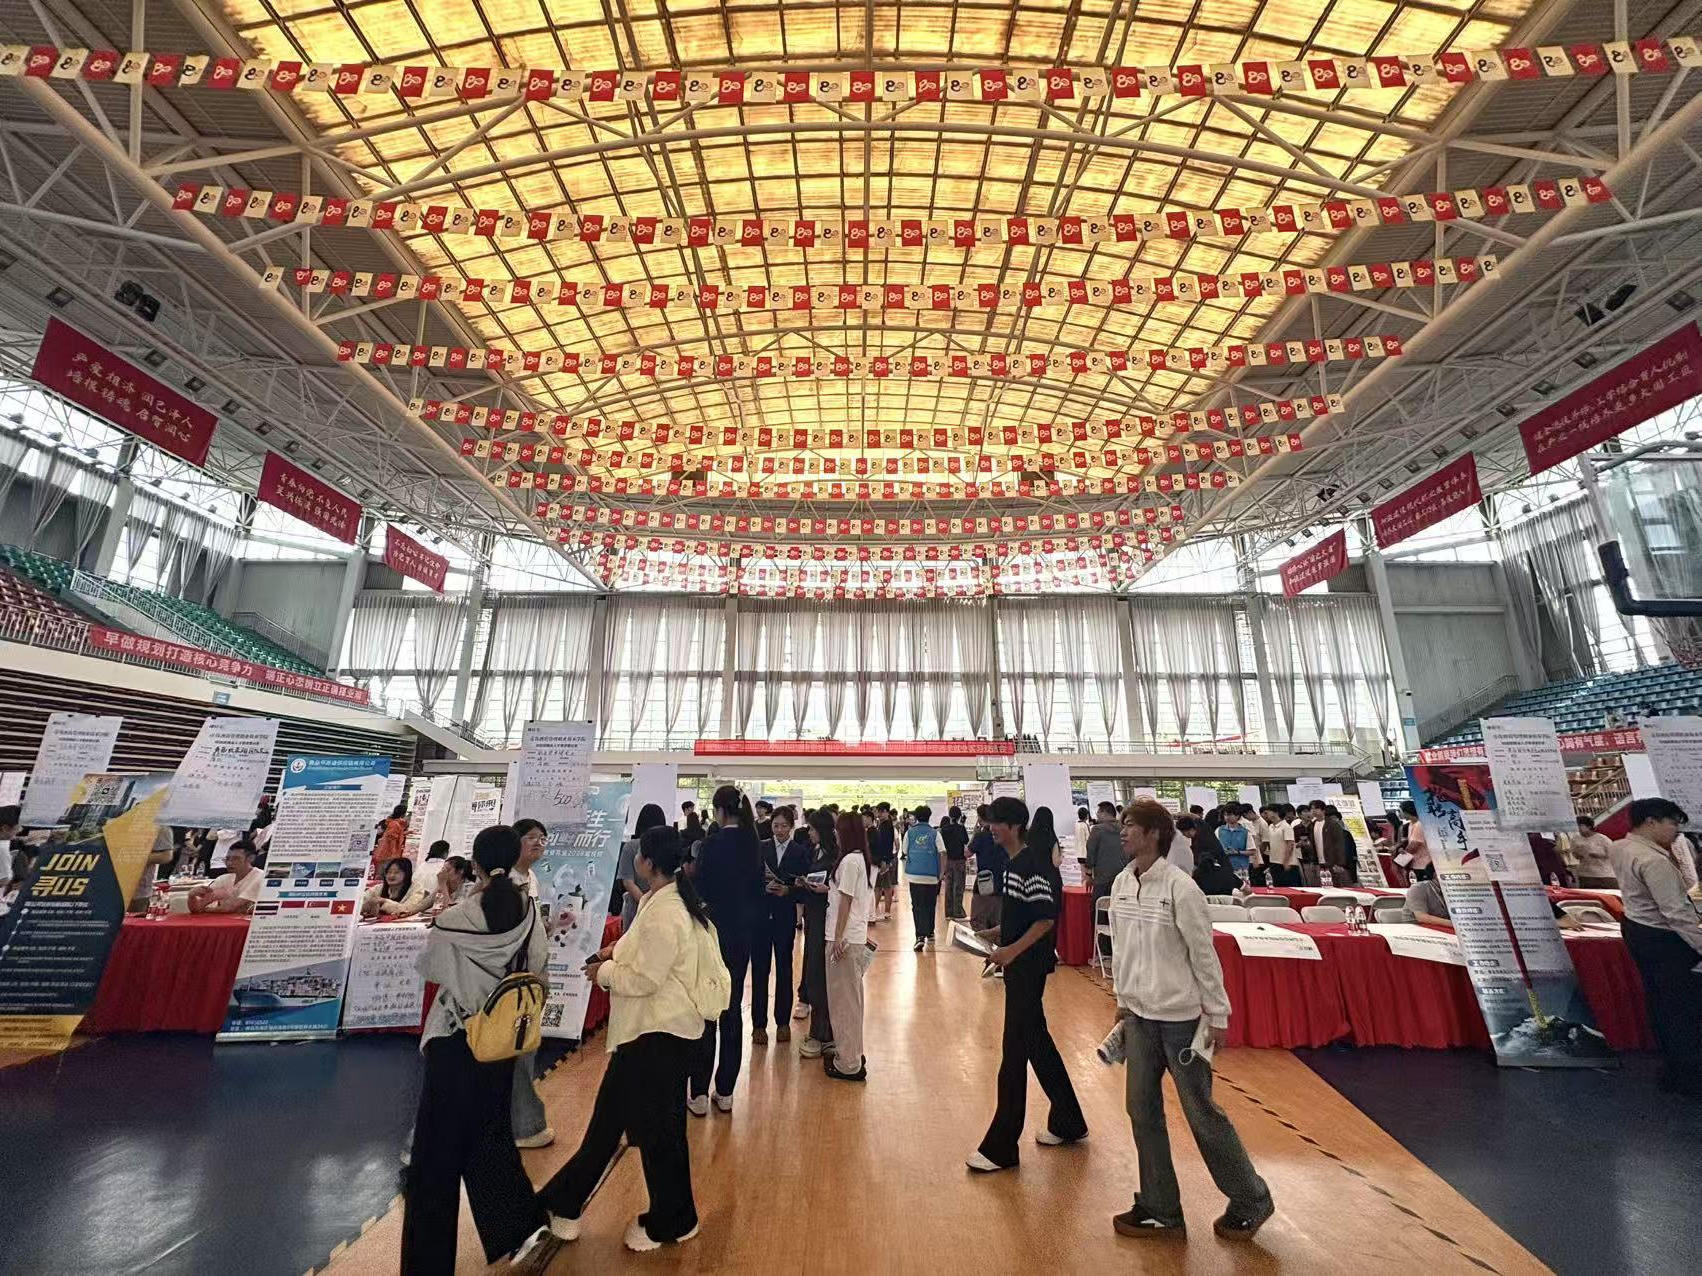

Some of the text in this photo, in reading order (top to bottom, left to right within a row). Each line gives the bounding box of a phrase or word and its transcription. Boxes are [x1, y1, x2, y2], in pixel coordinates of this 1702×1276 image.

[103, 630, 254, 677] 早做规划打造核心竞争力
[39, 853, 101, 871] JOIN
